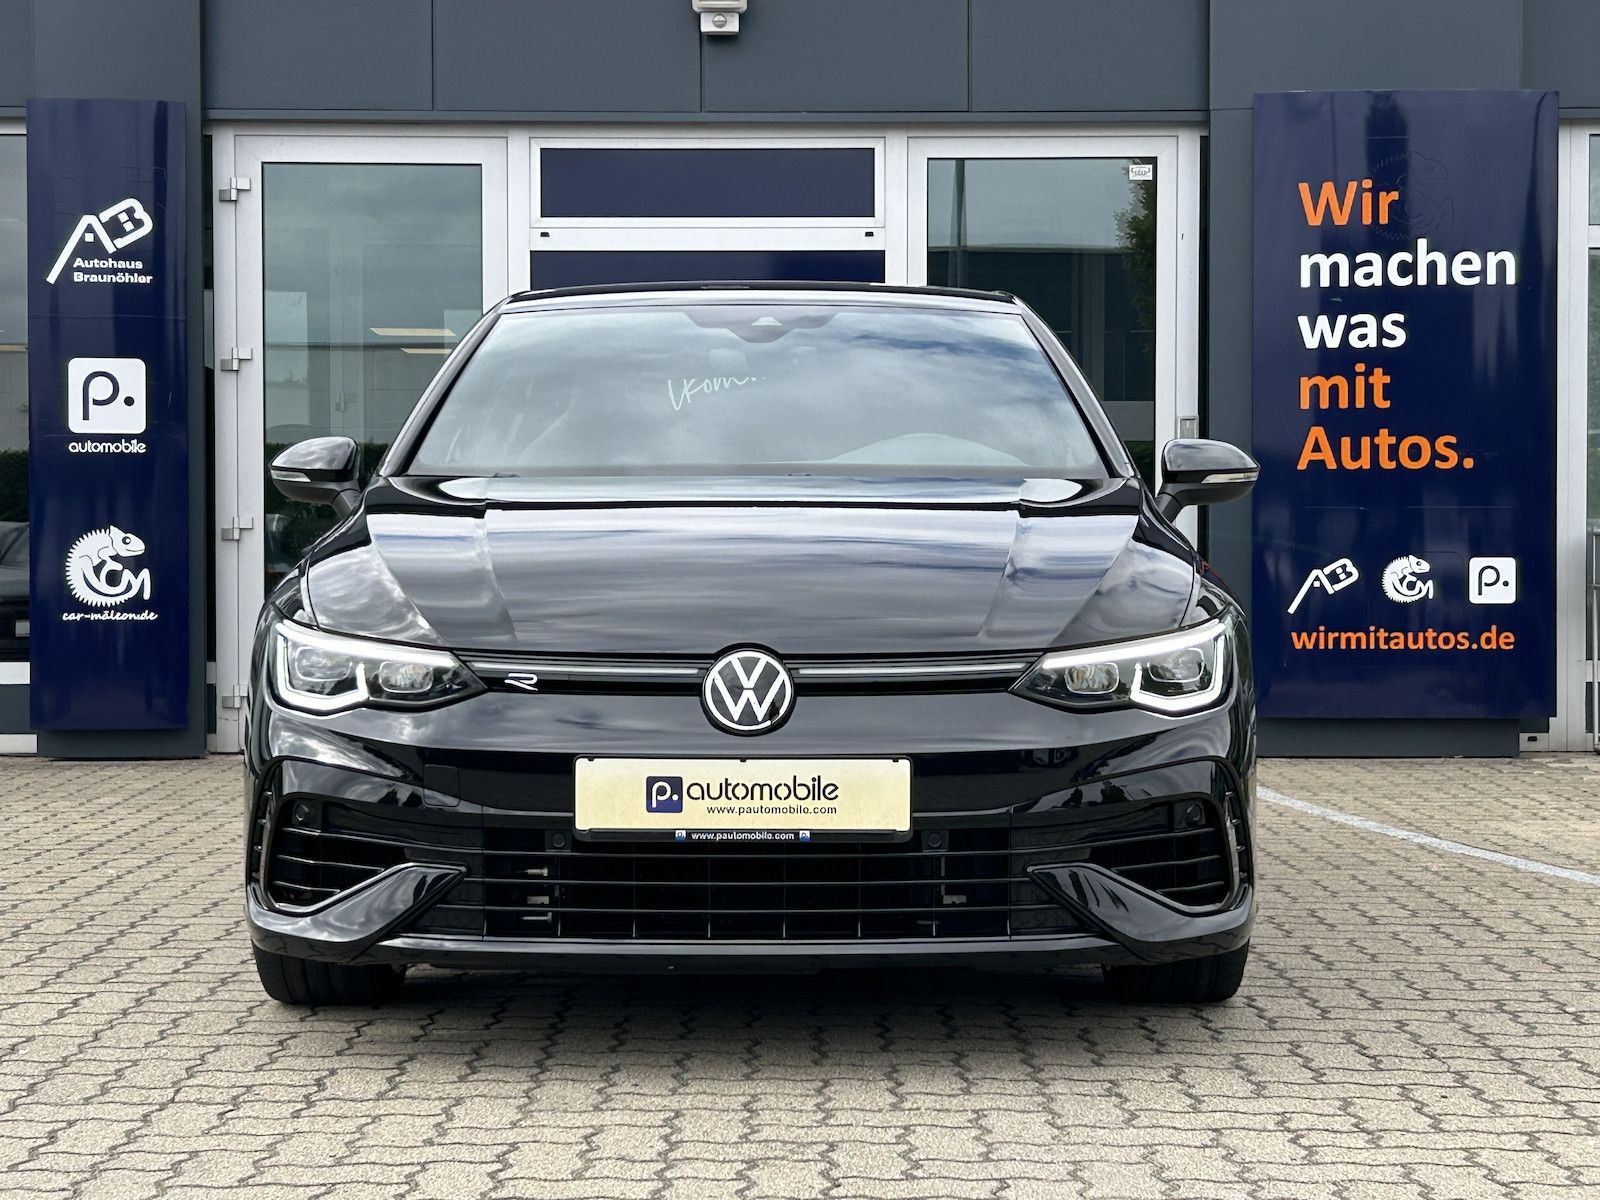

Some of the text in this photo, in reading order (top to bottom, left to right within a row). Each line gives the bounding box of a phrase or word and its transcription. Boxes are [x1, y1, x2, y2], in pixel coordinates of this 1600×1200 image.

[1298, 178, 1400, 226] Wir
[73, 257, 144, 270] Autohaus
[1299, 237, 1517, 288] machen
[73, 271, 153, 284] Braunöhler
[1297, 312, 1407, 349] was
[1299, 363, 1391, 410] mit
[68, 439, 147, 453] automobile
[1296, 426, 1475, 470] Autos.
[1291, 624, 1516, 650] wirmitautos.de
[686, 775, 839, 801] automobile
[706, 805, 837, 816] www.pautomobile.com
